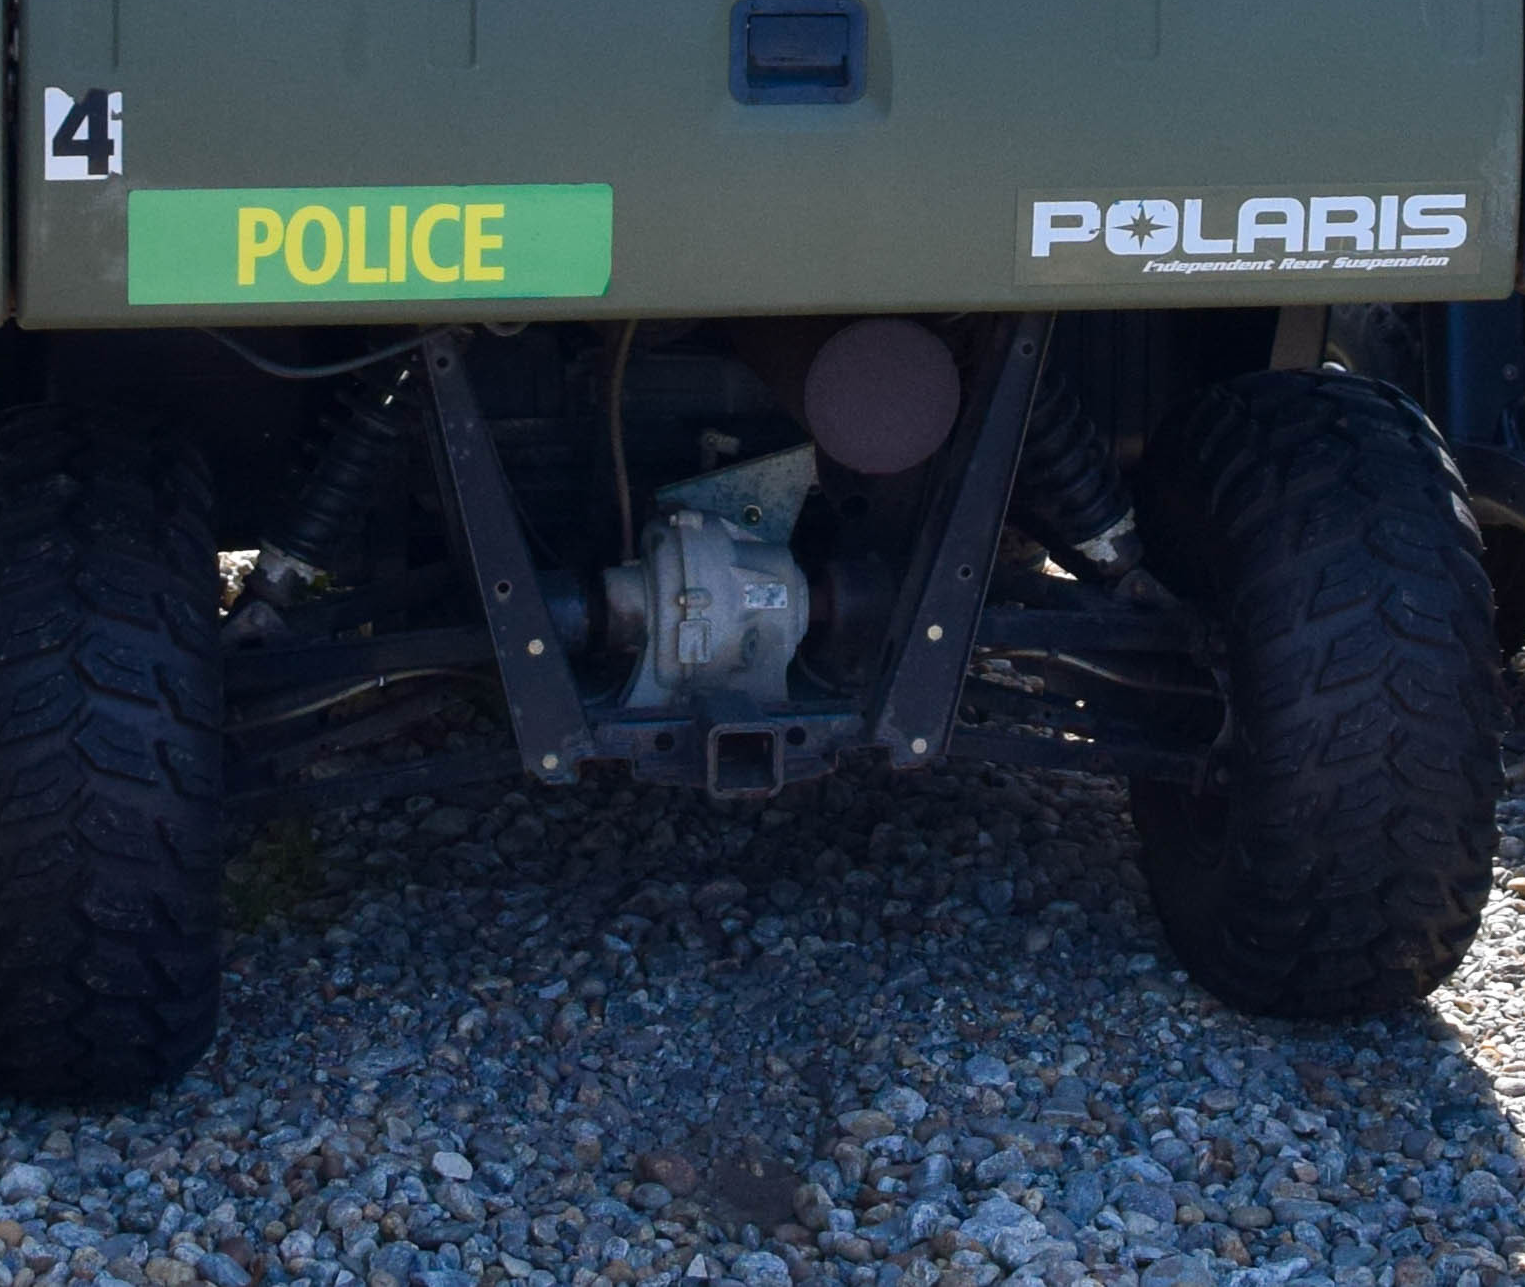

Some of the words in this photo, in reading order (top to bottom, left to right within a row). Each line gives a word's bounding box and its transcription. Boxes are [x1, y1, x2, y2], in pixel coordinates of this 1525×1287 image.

[52, 88, 115, 176] 4
[237, 202, 506, 287] POLICE
[1031, 193, 1467, 258] POLARIS
[1142, 259, 1274, 275] Independent
[1278, 257, 1330, 270] Rear
[1332, 255, 1450, 271] Suspension
